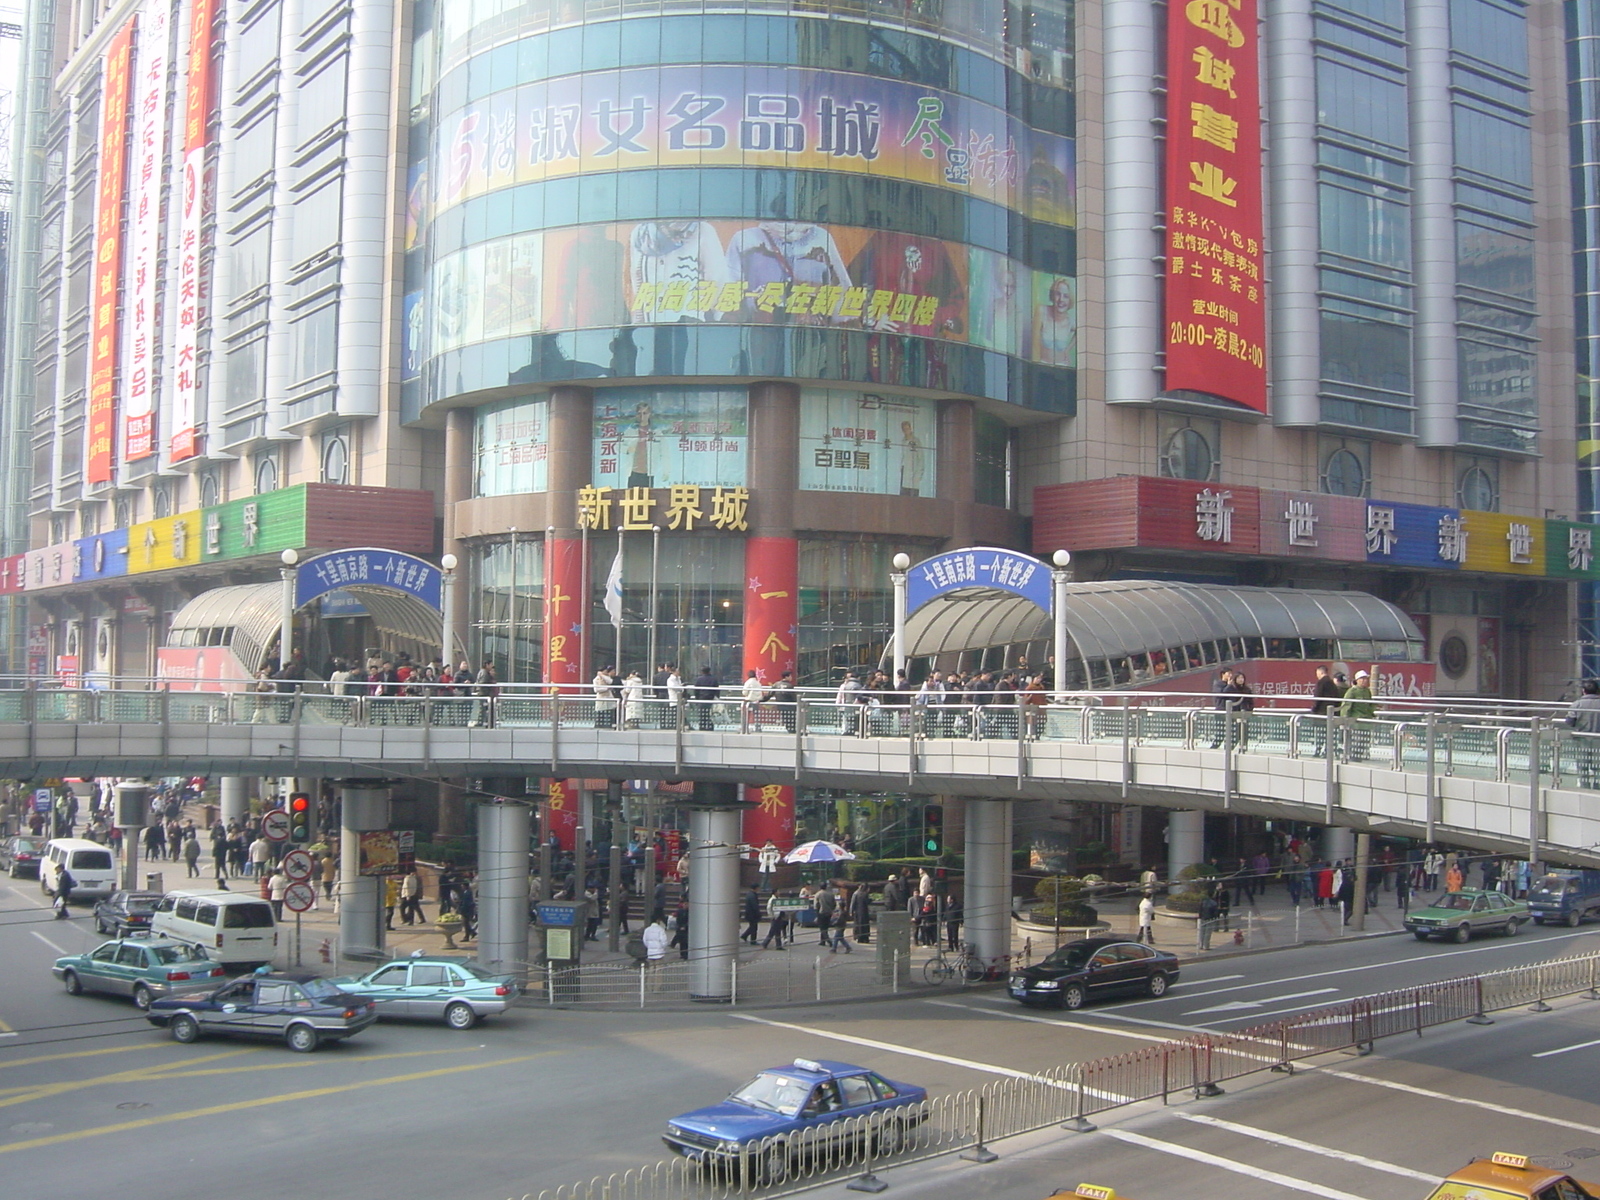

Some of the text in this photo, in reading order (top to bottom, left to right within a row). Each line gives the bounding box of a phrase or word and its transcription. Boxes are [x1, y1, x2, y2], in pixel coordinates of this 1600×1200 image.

[529, 92, 880, 167] 淑女名品城
[1188, 45, 1240, 208] 试营业
[1193, 298, 1239, 327] 营业时间
[600, 405, 618, 475] 上海永新
[678, 440, 738, 453] 引领时尚
[577, 484, 749, 532] 新世界城
[315, 554, 430, 592] 十里南京路 一个新世界
[923, 553, 1036, 590] 十里南京路 一个新世界
